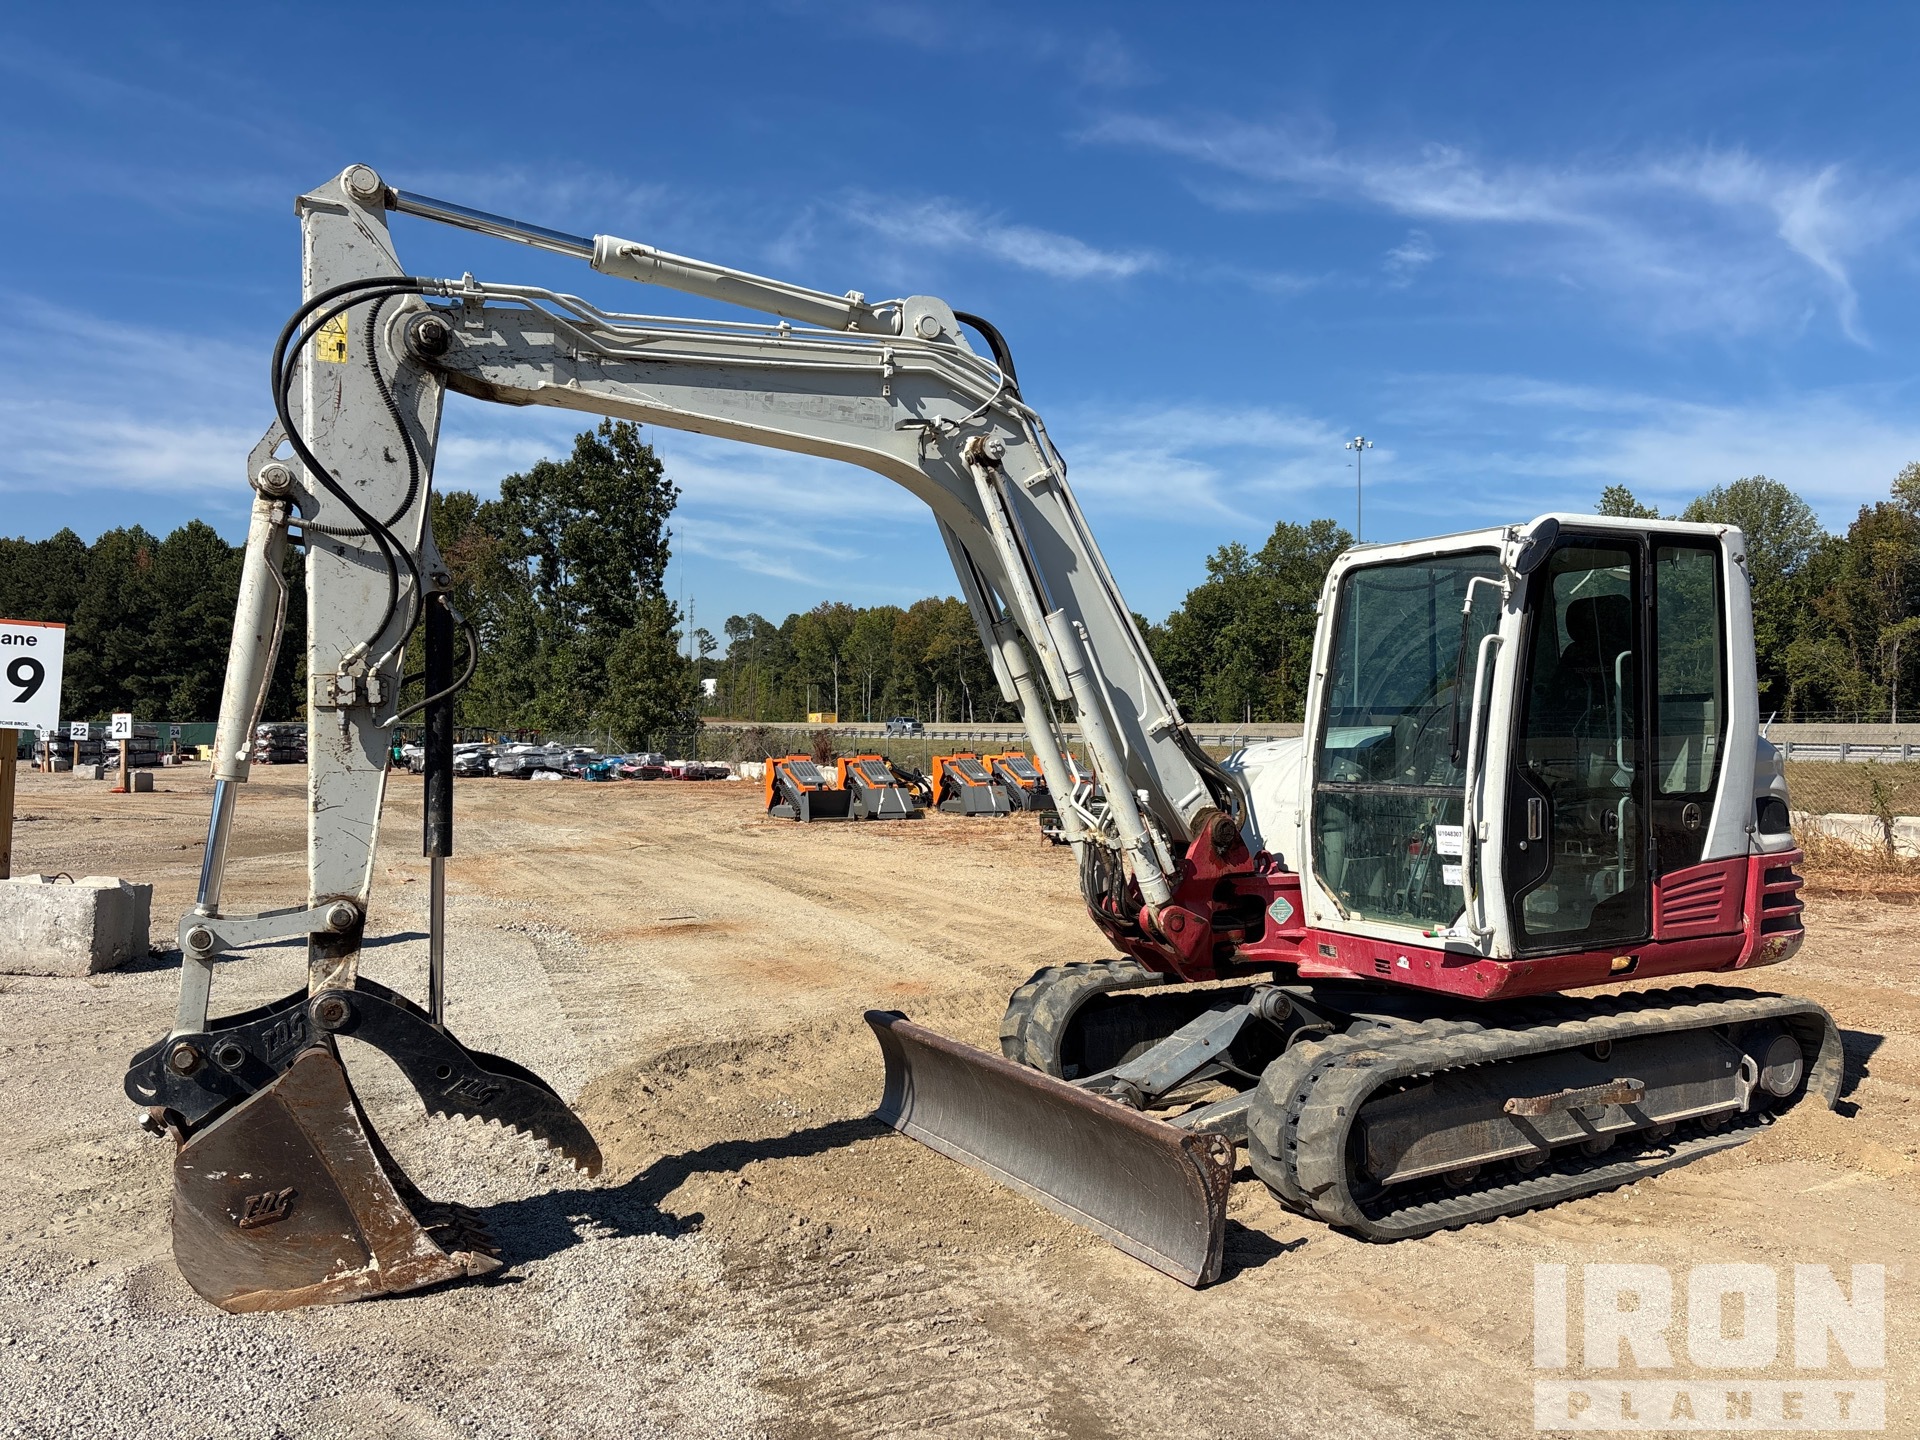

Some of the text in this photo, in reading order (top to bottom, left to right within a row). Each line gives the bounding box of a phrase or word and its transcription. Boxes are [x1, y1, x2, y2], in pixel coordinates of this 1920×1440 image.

[0, 633, 38, 647] ane
[6, 656, 45, 703] 9
[72, 727, 87, 737] 22
[115, 721, 127, 733] 21
[41, 730, 49, 738] 23
